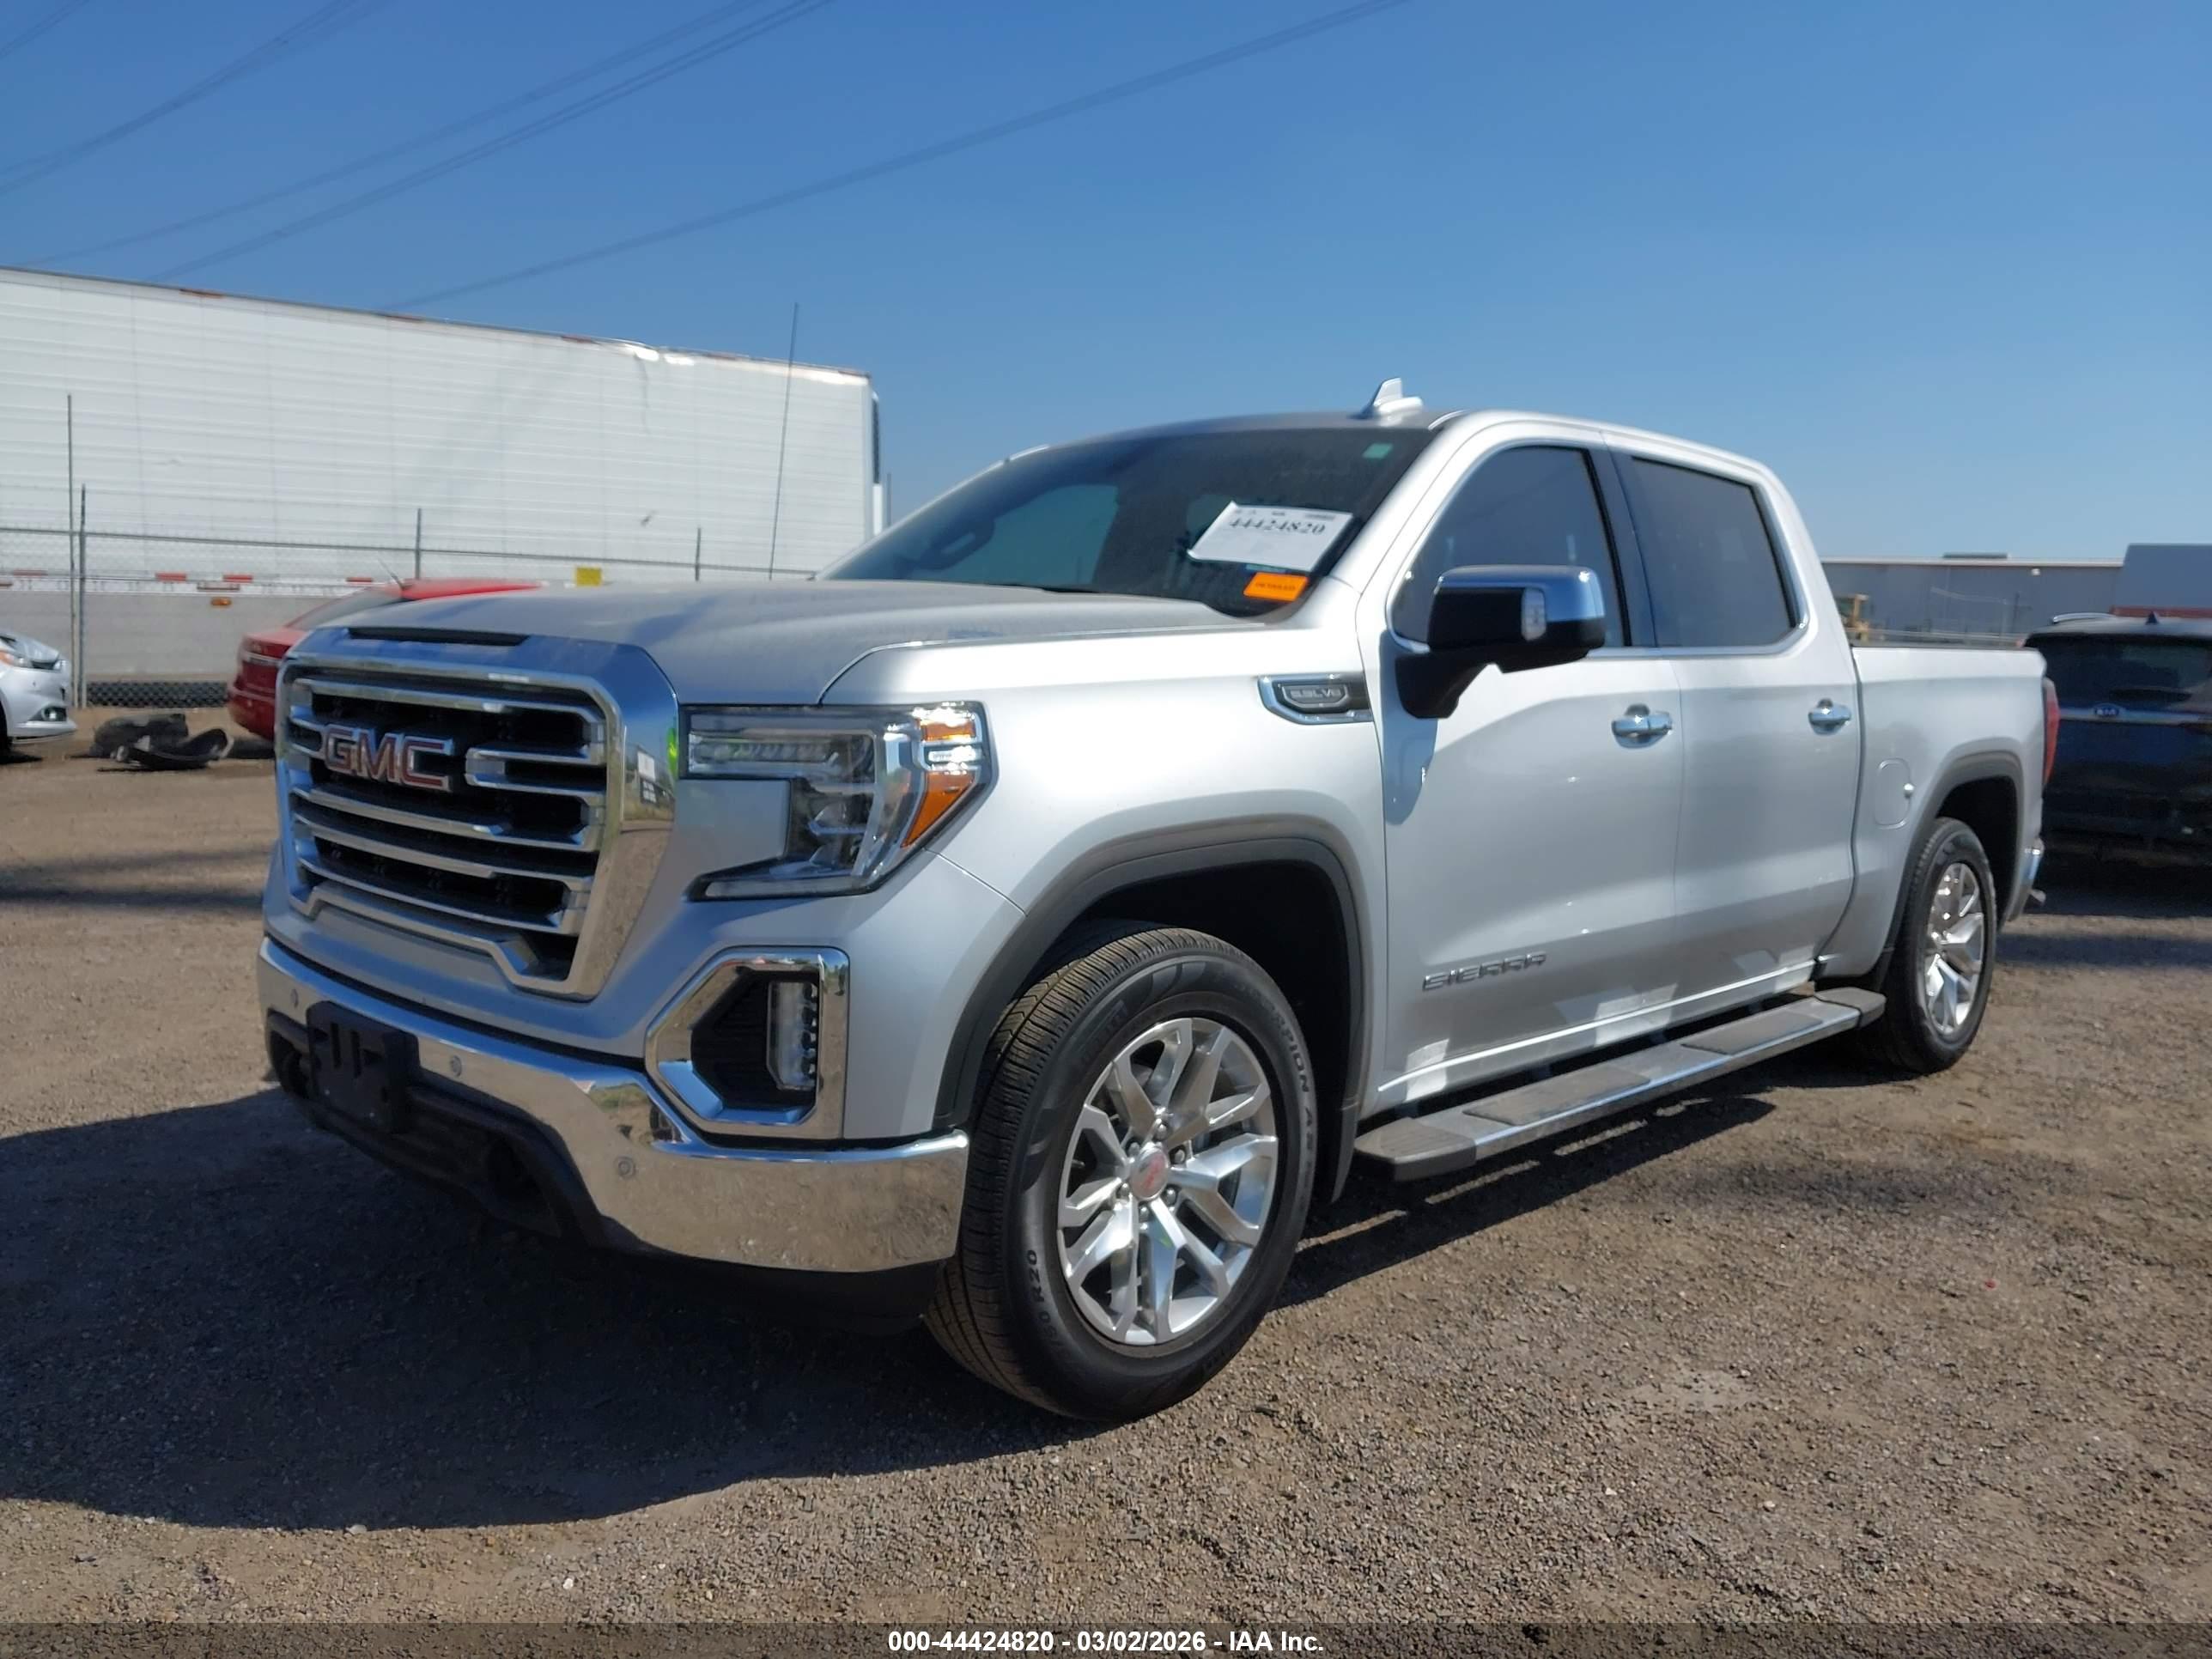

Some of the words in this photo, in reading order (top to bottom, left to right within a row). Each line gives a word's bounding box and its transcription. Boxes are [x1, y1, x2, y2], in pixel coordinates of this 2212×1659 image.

[1230, 517, 1326, 536] 44424820
[324, 723, 453, 793] GMC
[1422, 951, 1547, 993] SIERRA
